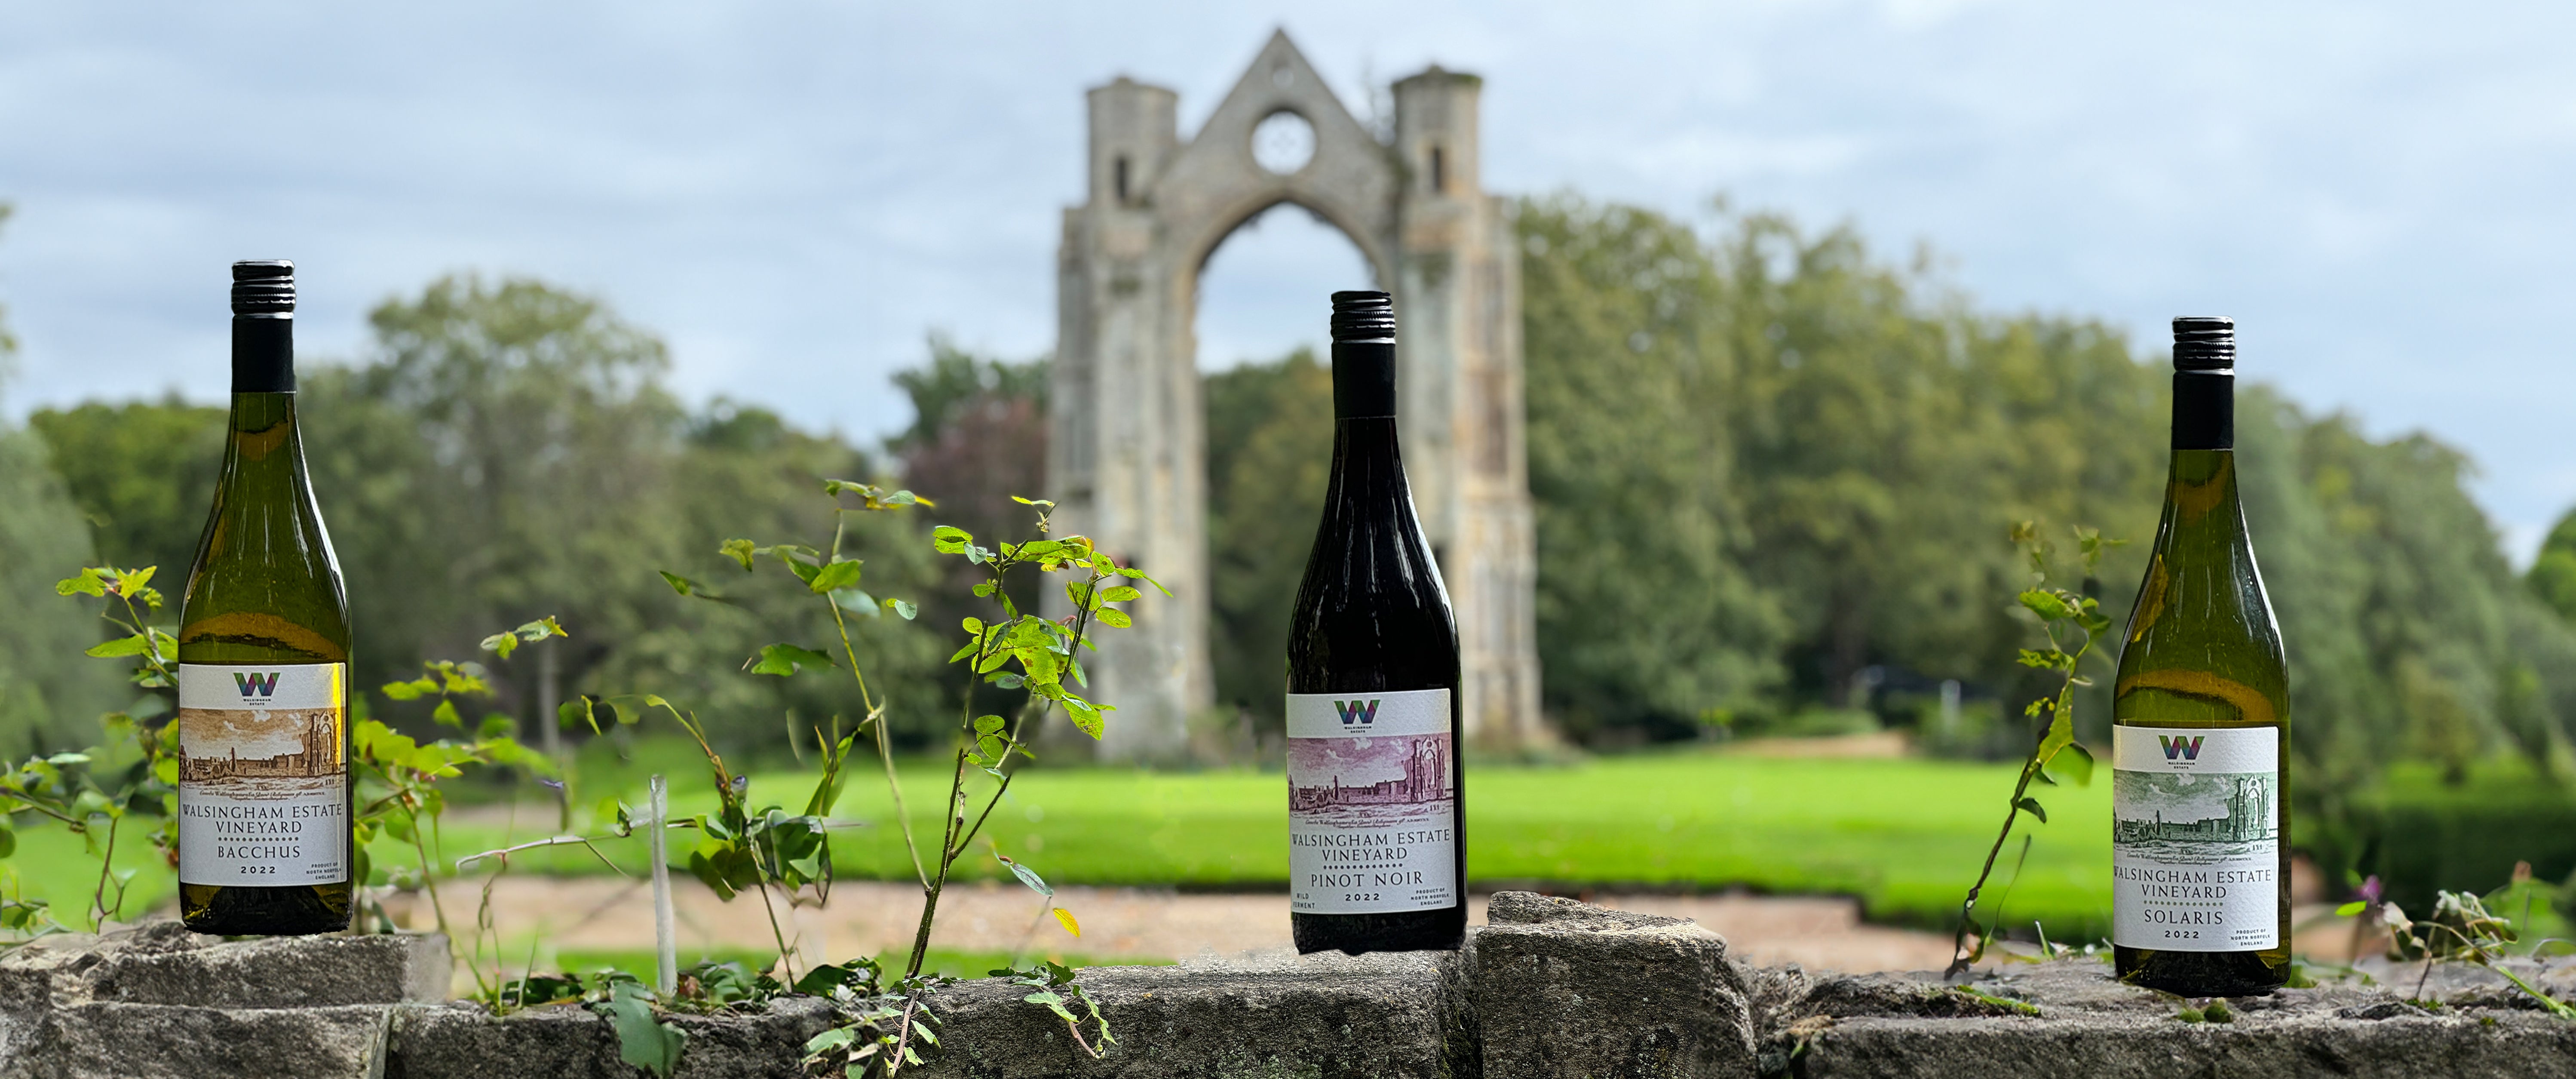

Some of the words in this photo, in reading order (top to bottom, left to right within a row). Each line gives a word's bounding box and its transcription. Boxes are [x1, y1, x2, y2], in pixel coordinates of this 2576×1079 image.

[183, 804, 283, 818] WALSINGHAM
[292, 803, 342, 818] ESTATE
[216, 821, 302, 833] VINEYARD
[1292, 834, 1388, 846] WALSINGHAM
[1398, 829, 1450, 844] ESTATE
[218, 846, 300, 858] BACCHUS
[1322, 848, 1407, 861] VINEYARD
[1311, 874, 1365, 887] PINOT
[1376, 872, 1423, 885] NOIR
[2114, 865, 2207, 883] WALSINGHAM
[2217, 870, 2271, 883] ESTATE
[2141, 885, 2226, 898] VINEYARD
[2144, 910, 2223, 924] SOLARIS
